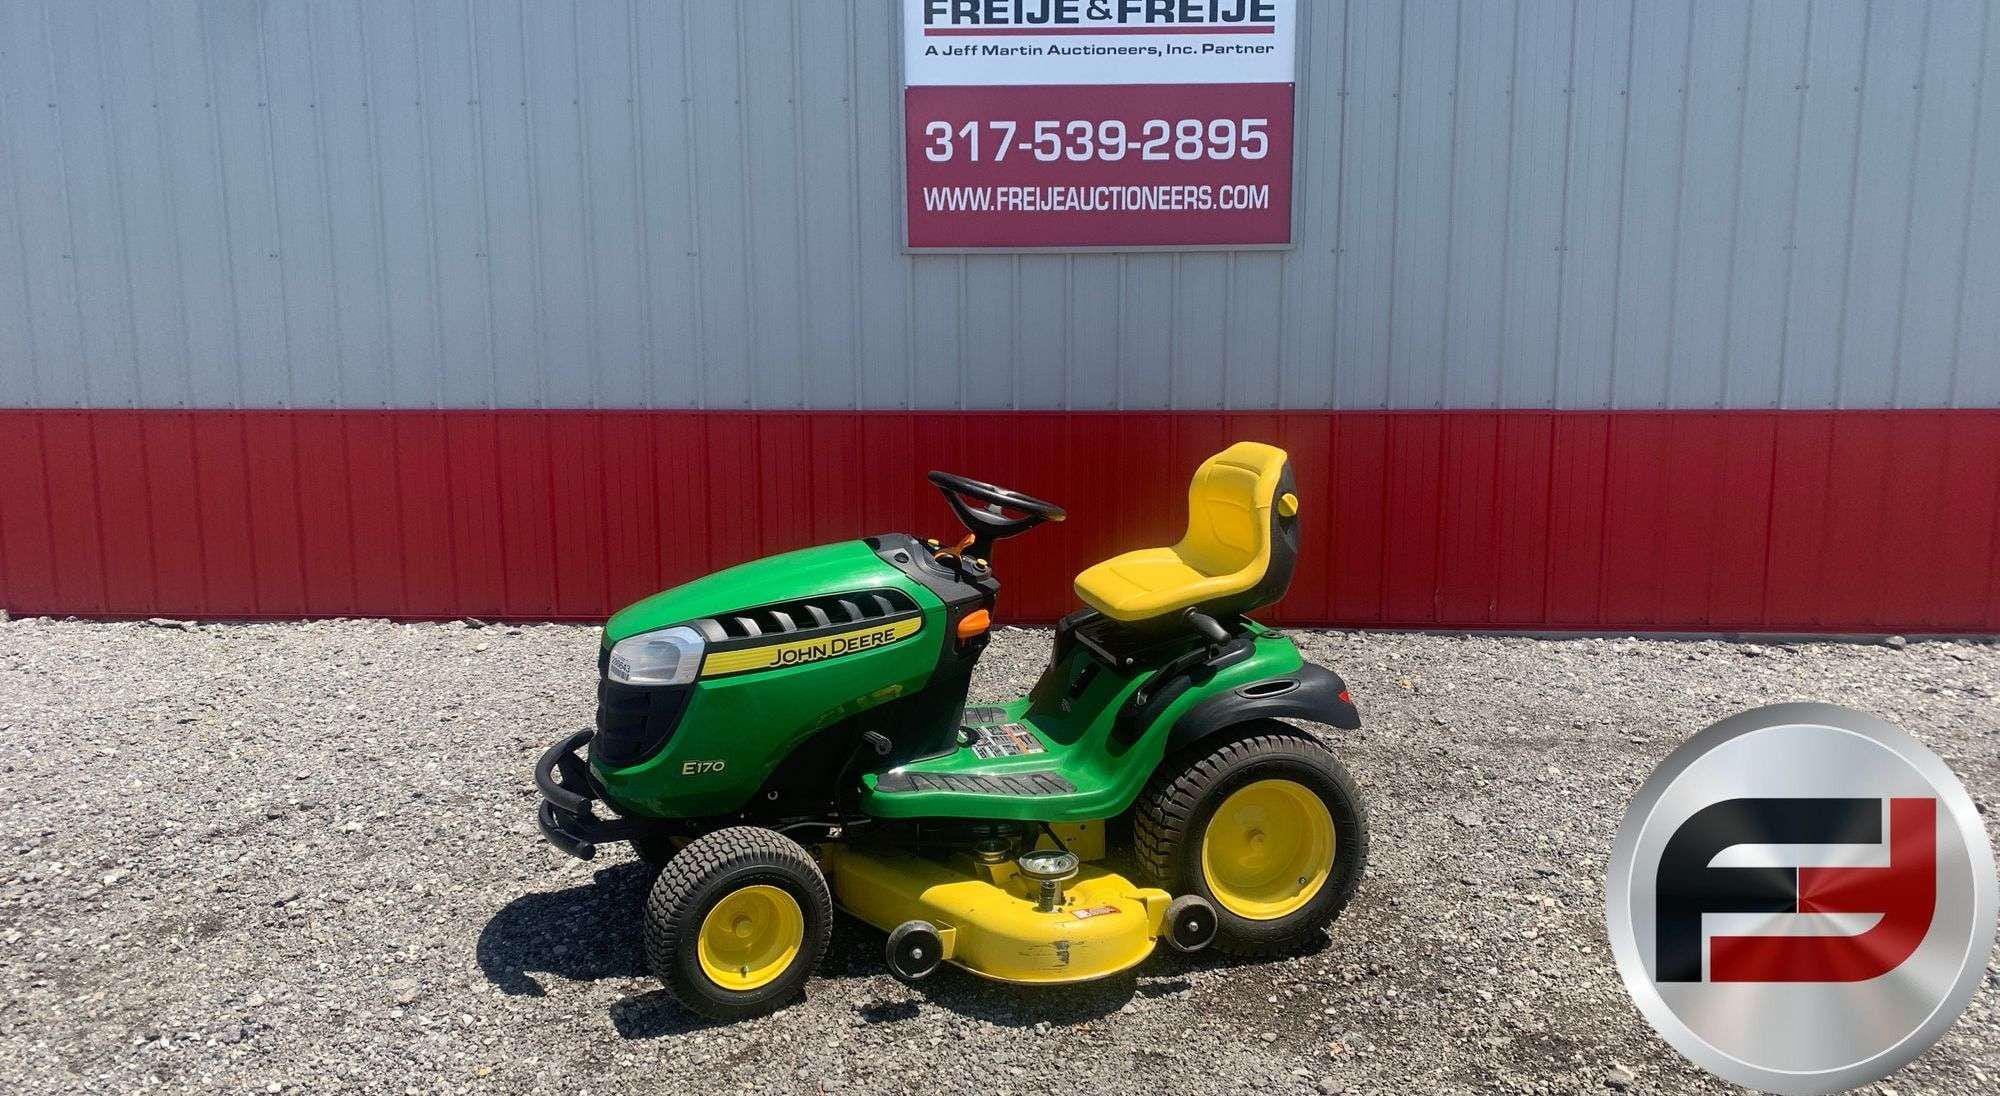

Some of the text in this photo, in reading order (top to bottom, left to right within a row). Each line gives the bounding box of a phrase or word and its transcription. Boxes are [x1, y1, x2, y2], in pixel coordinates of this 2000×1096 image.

[924, 43, 1275, 58] A Jeff Martin Auctioneers, Inc. Partner
[925, 118, 1269, 162] 317-539-2895
[923, 185, 1269, 211] WWW.FREIJEAUCTIONEERS.COM
[769, 627, 897, 667] JOHN DEERE
[682, 761, 725, 775] E170
